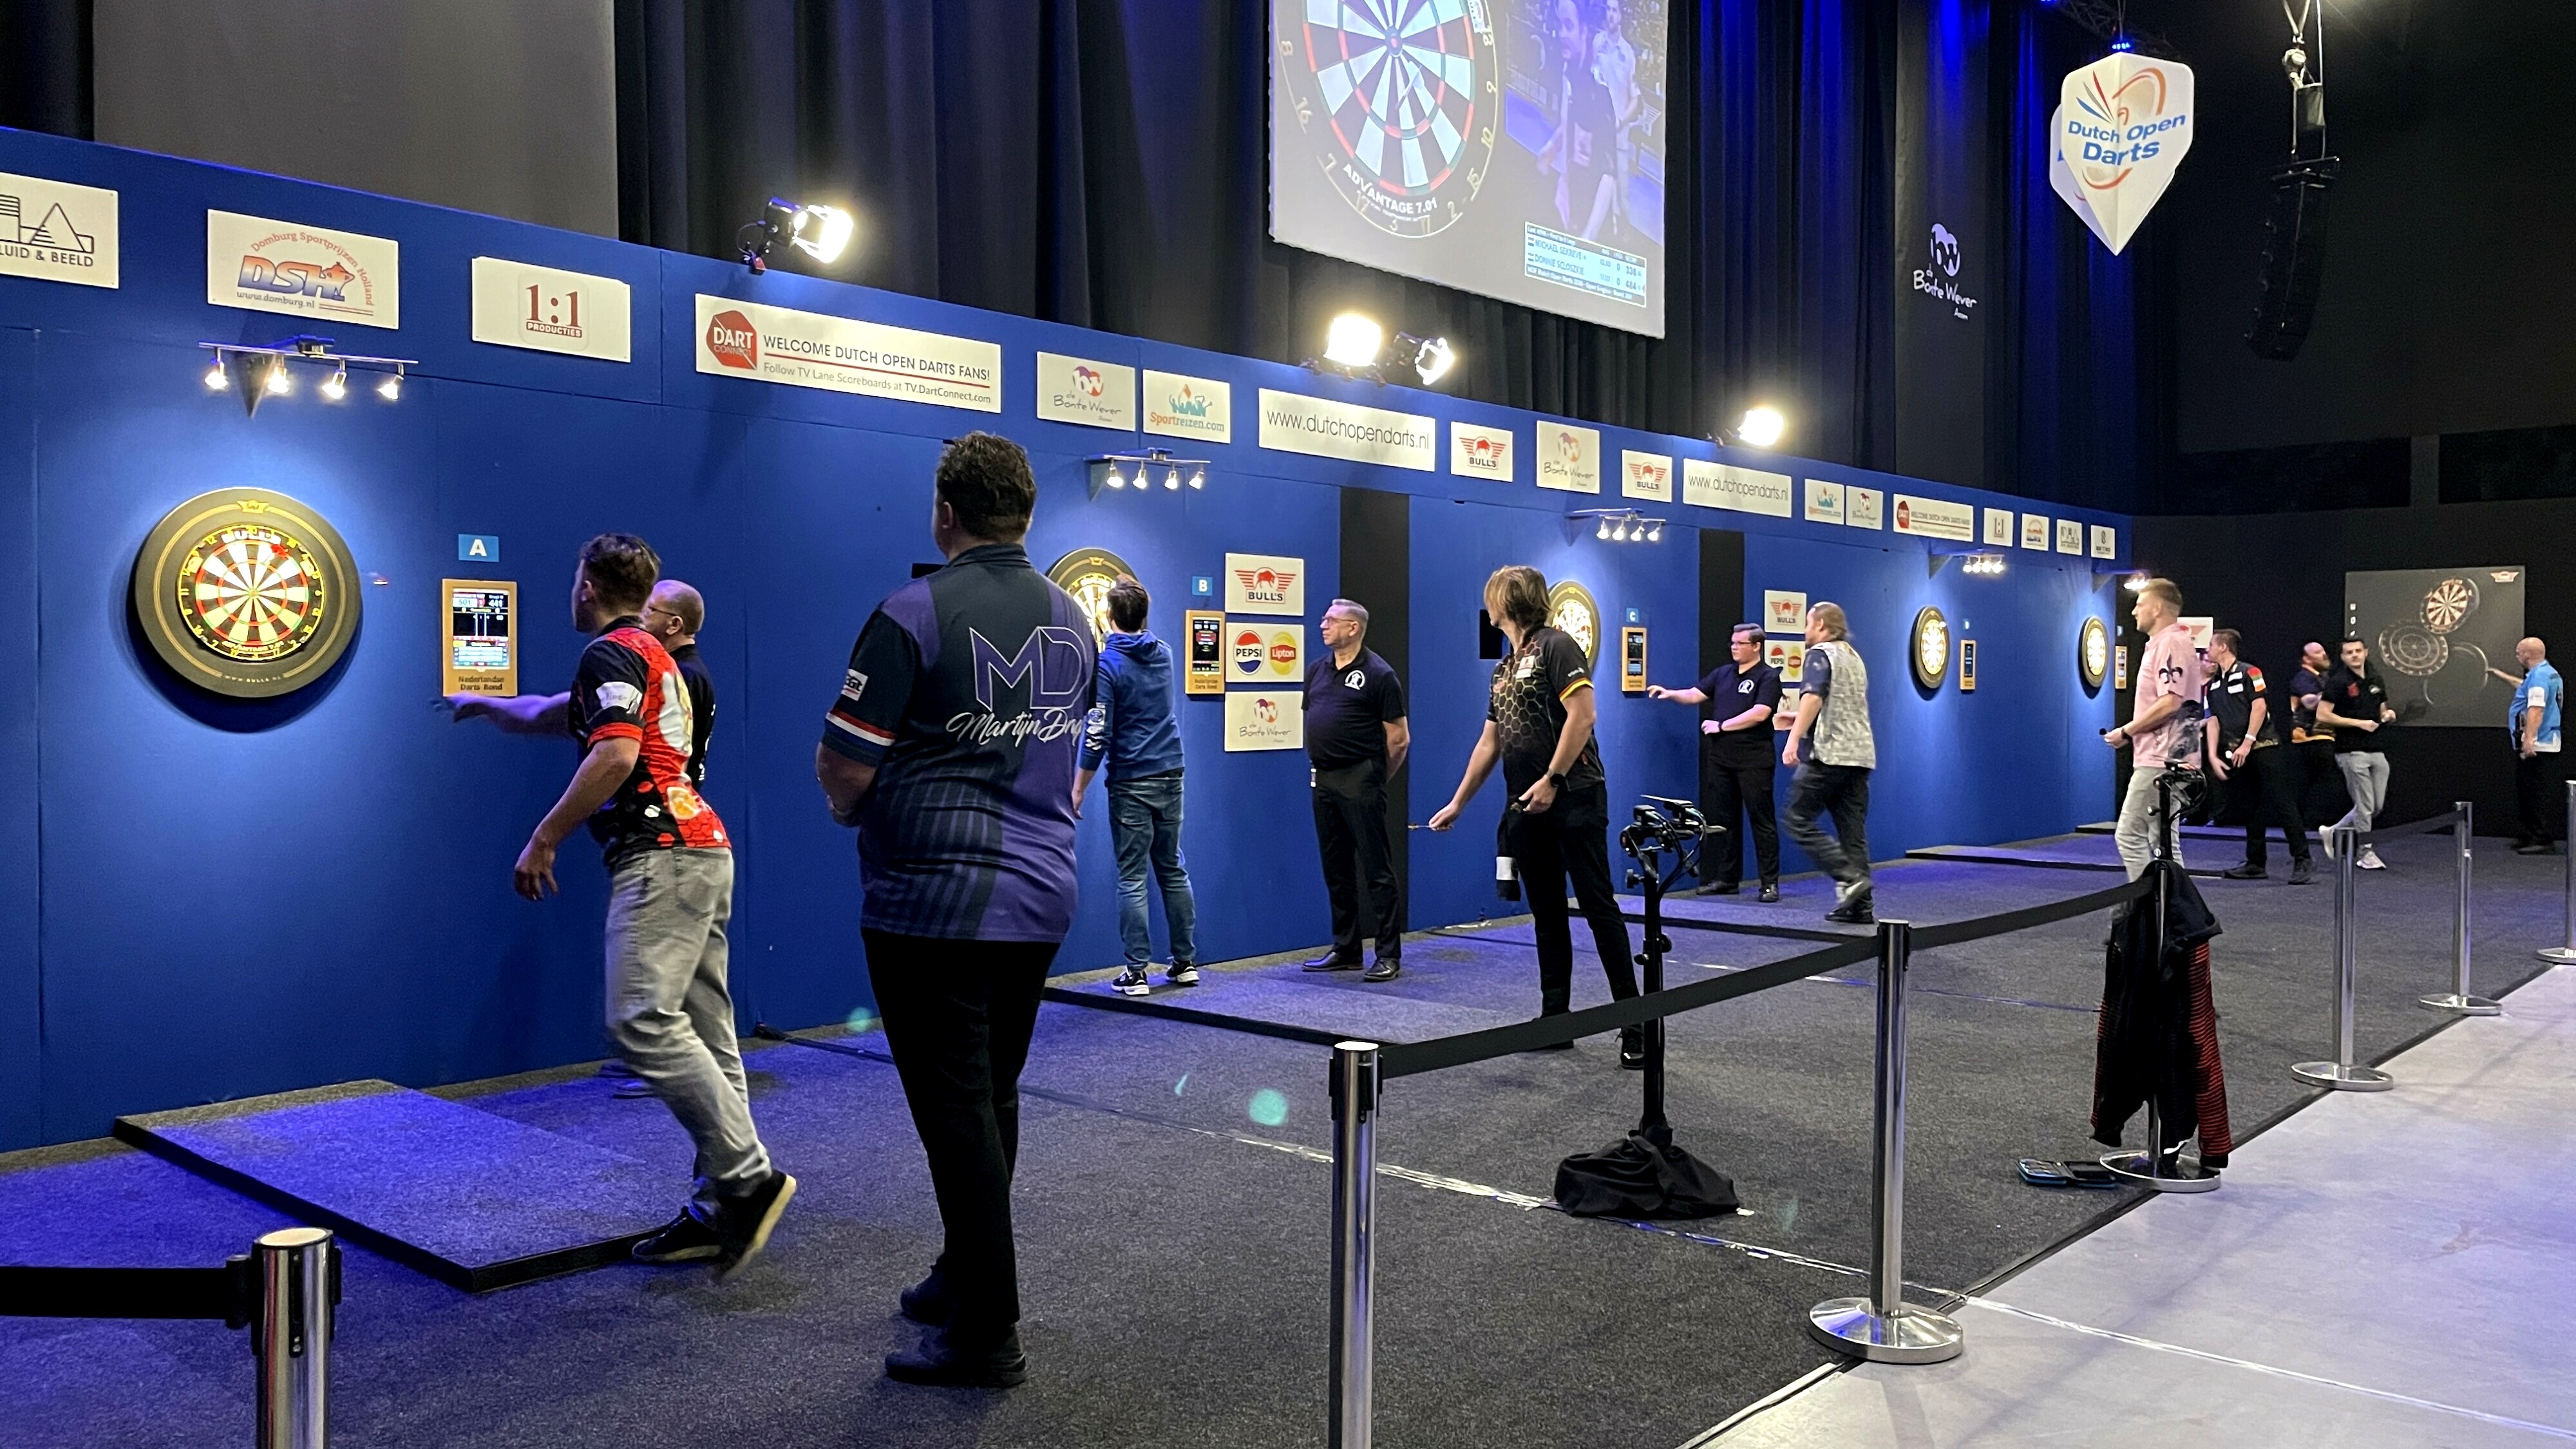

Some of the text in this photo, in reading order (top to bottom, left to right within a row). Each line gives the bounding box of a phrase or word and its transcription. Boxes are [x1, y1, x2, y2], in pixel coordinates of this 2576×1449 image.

[2067, 114, 2186, 144] Dutch Open
[2083, 141, 2161, 166] Darts
[1343, 163, 1414, 214] ADVANTAGE
[1416, 196, 1437, 214] 7.01
[251, 232, 298, 252] Domburg
[35, 250, 45, 261] &
[51, 251, 94, 267] BEELD
[299, 232, 375, 306] Sportprijzen Holland
[236, 292, 316, 308] www.domburg.nl
[526, 284, 582, 328] 1:1
[527, 322, 582, 337] PRODUCTIES
[713, 326, 753, 350] DART
[763, 334, 990, 381] WELCOME DUTCH OPEN DARTS FANS!
[764, 362, 991, 404] Follow TV Lane Scoreboards at TV.DartConnect.com
[1053, 394, 1122, 415] Bonte Wever
[1150, 412, 1225, 432] Sportreizen.com
[1266, 409, 1430, 450] www.dutchopendarts.nl
[1468, 457, 1497, 468] BULL'S
[469, 538, 488, 556] A
[1198, 579, 1208, 592] B
[1247, 591, 1283, 602] BULL'S
[1236, 648, 1262, 658] PEPSI
[1271, 648, 1295, 659] Lipton
[969, 625, 1088, 712] MD
[945, 710, 1041, 748] Martijn
